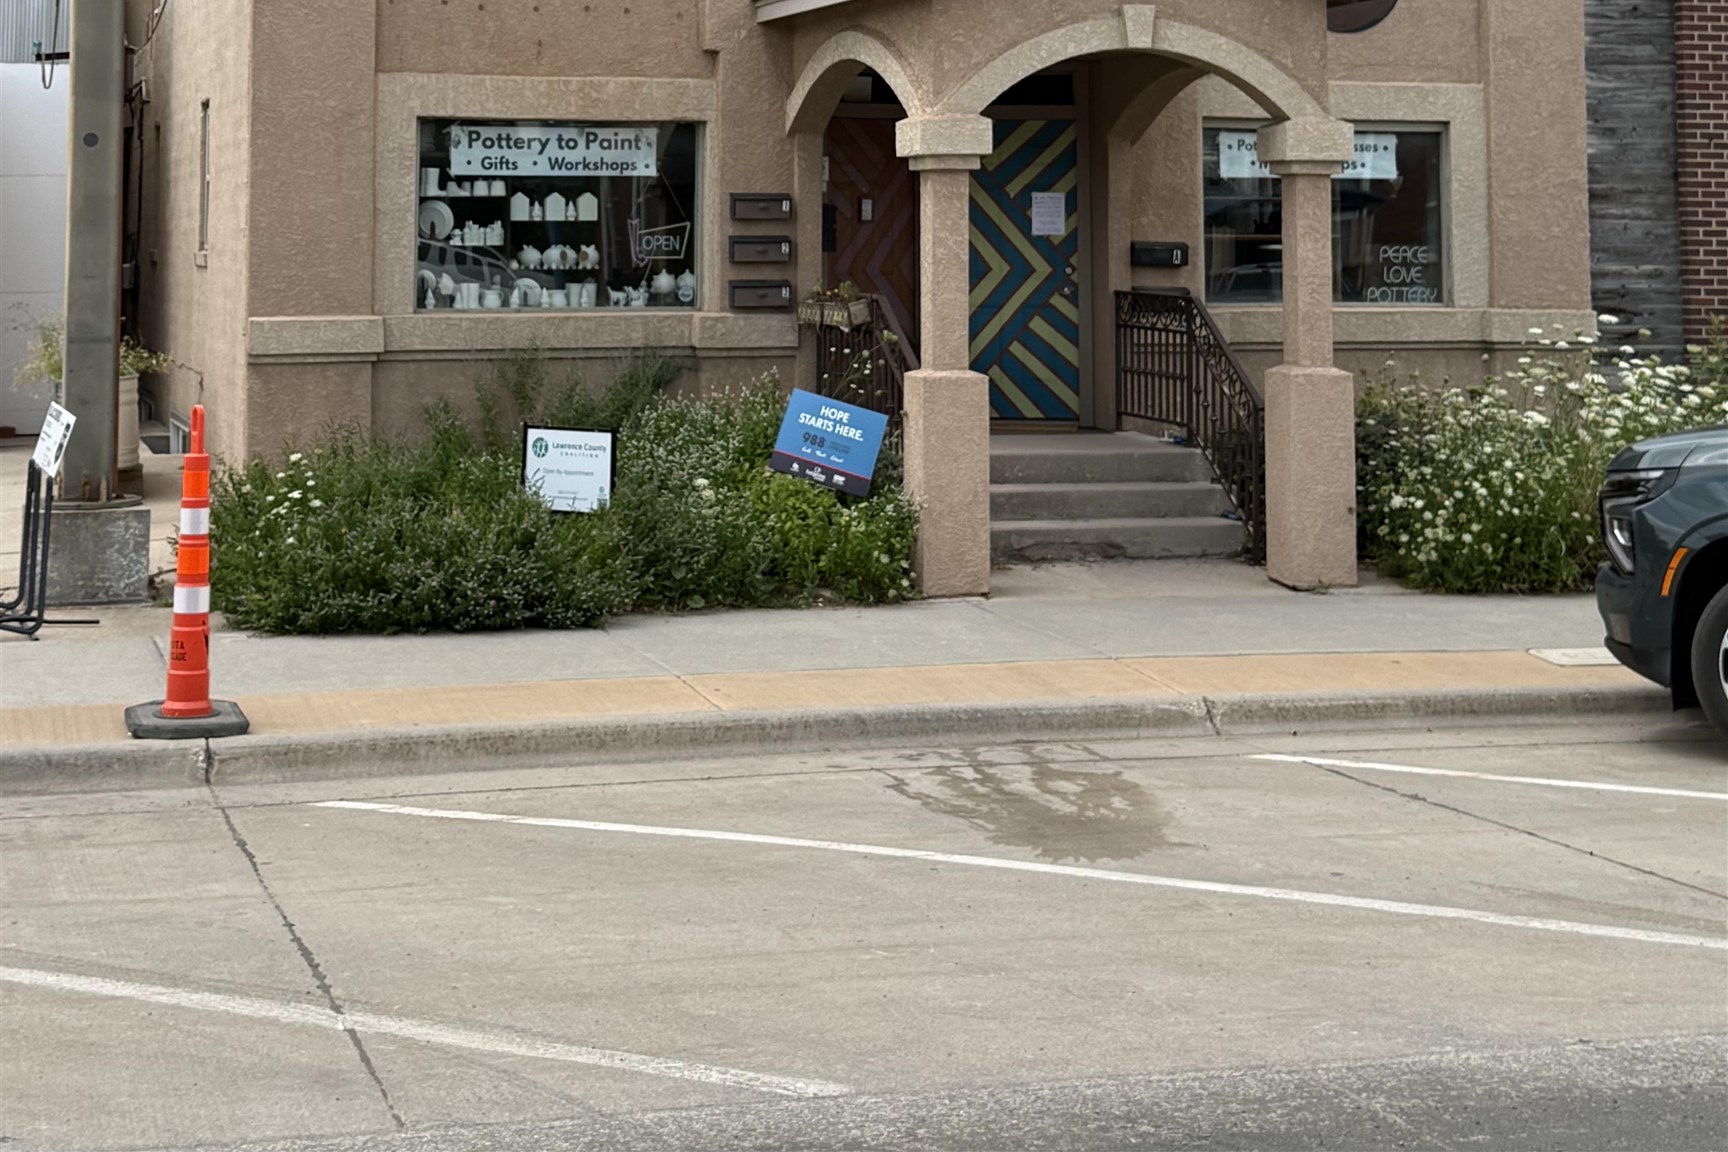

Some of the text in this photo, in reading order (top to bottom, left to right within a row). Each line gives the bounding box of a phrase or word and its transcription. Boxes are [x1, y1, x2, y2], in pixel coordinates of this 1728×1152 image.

[467, 130, 642, 155] Pottery to Paint
[480, 156, 638, 174] Gifts Workshops
[642, 235, 680, 251] OPEN
[1379, 246, 1428, 264] PEACE
[1383, 266, 1423, 283] LOVE
[1367, 287, 1437, 303] POTTERY
[820, 406, 850, 423] HOPE
[798, 412, 864, 442] STARTS HERE.
[552, 442, 607, 453] Lawrence County
[803, 432, 826, 448] 988
